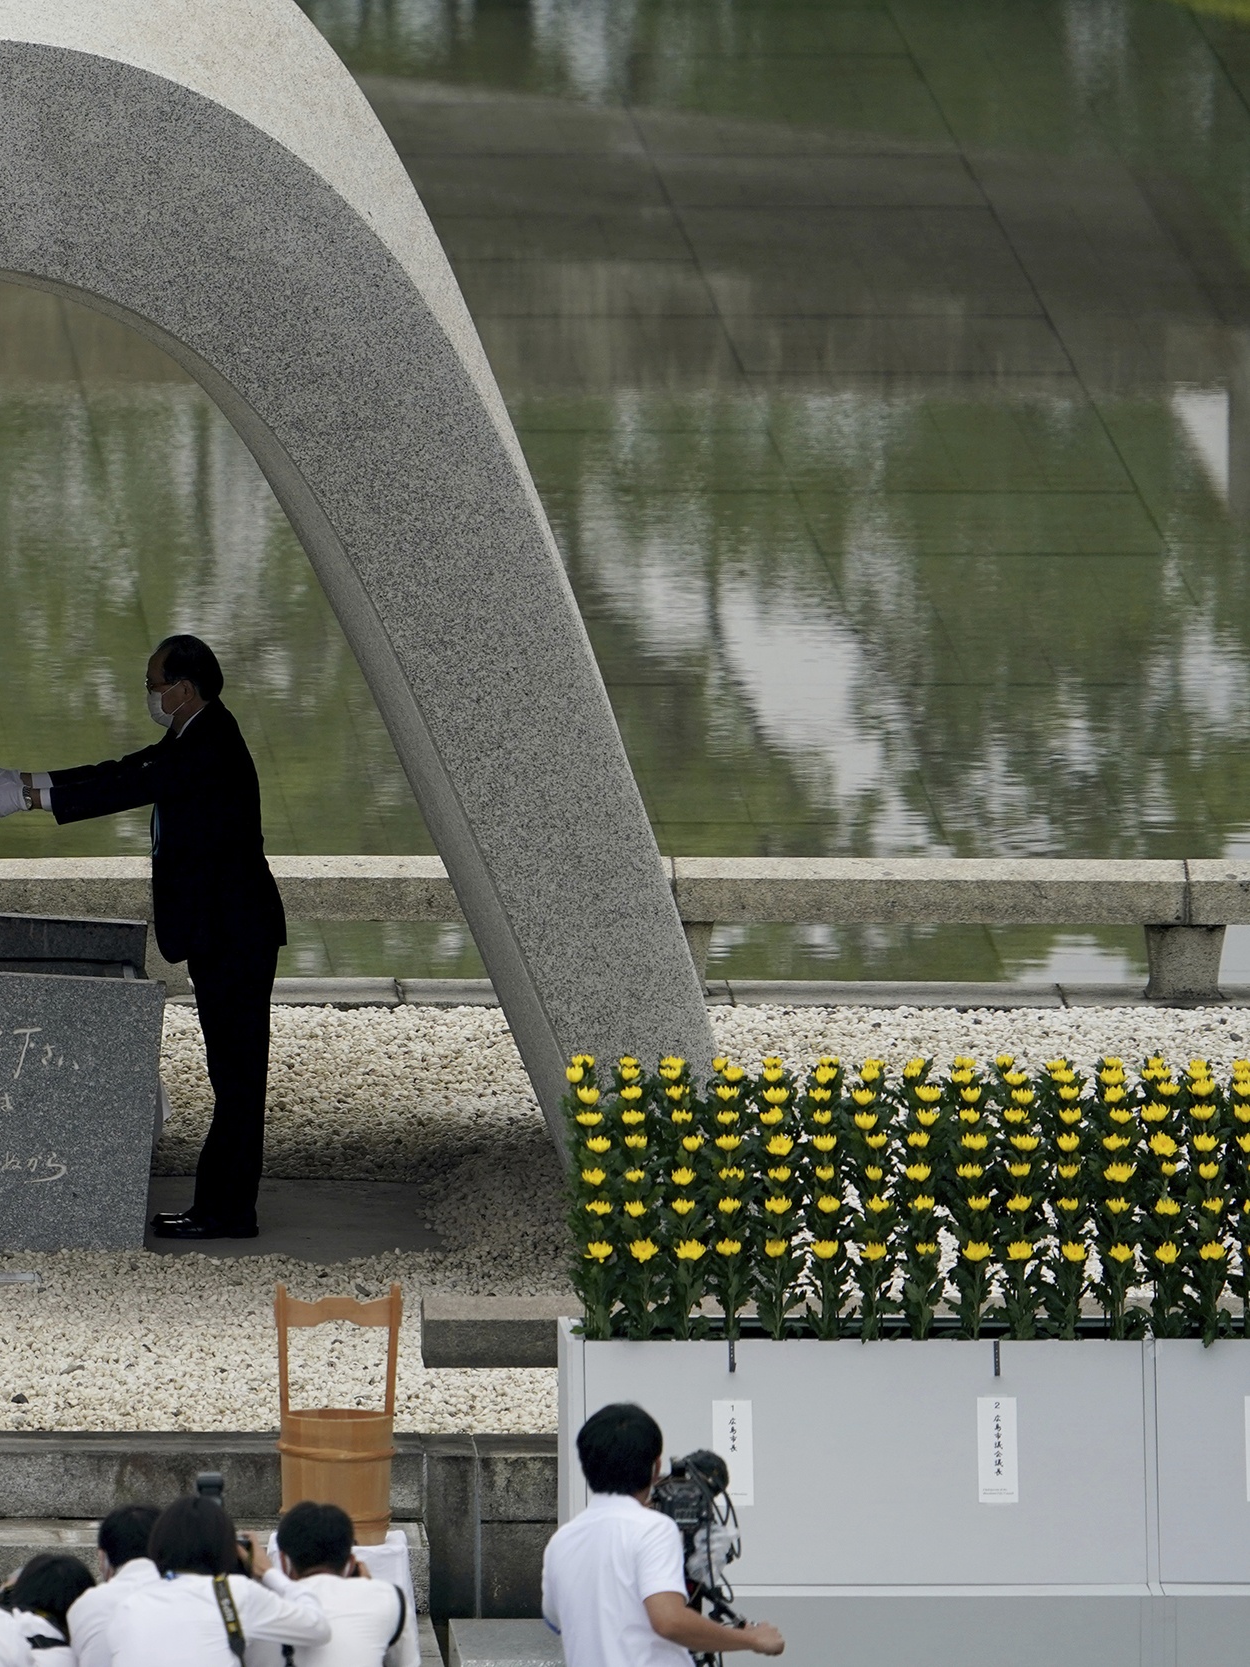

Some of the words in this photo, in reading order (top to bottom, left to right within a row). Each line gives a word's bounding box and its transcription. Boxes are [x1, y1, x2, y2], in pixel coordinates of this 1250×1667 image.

[994, 1401, 1001, 1409] 2
[728, 1417, 738, 1453] 広島市長
[993, 1414, 1004, 1476] 広島市議会議長
